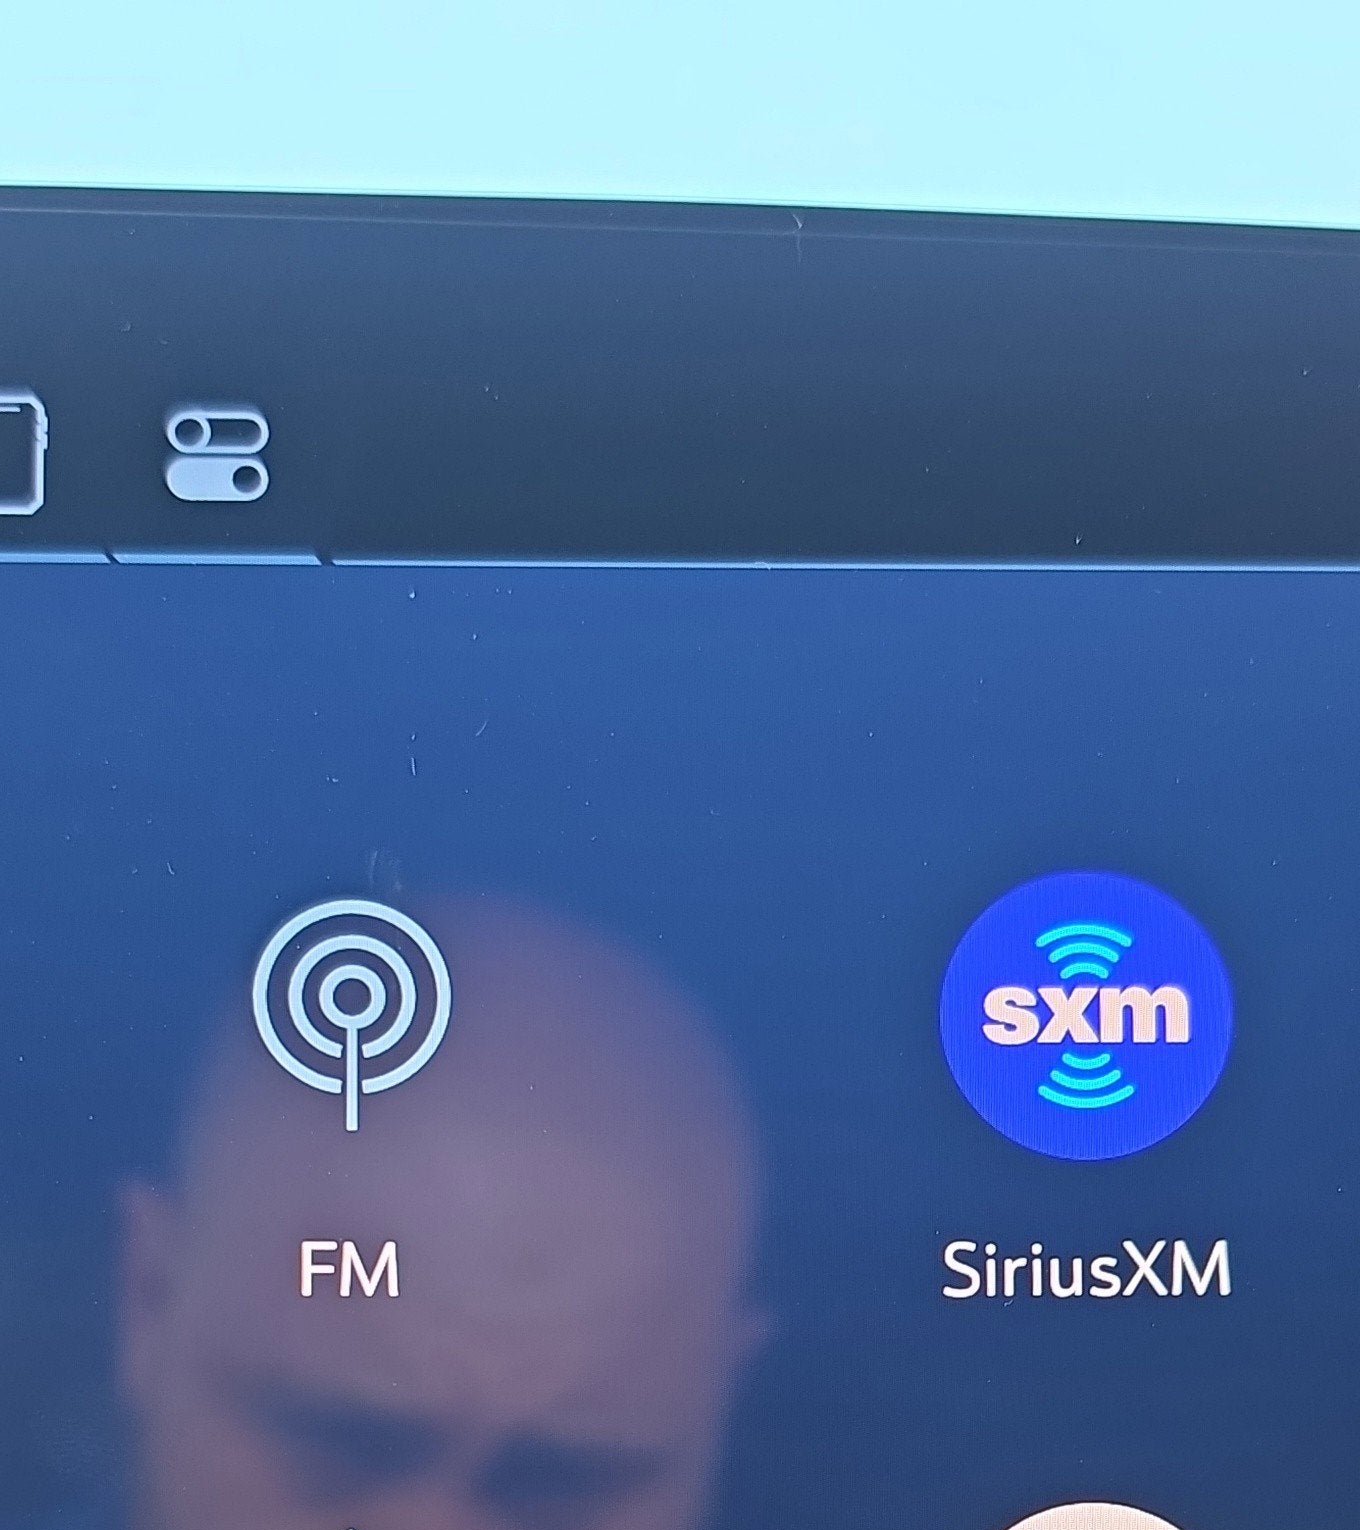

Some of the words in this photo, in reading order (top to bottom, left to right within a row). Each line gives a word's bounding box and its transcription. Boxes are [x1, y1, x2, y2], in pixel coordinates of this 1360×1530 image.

[981, 984, 1191, 1047] sxm
[300, 1240, 401, 1298] FM
[941, 1240, 1232, 1300] SiriusXM
